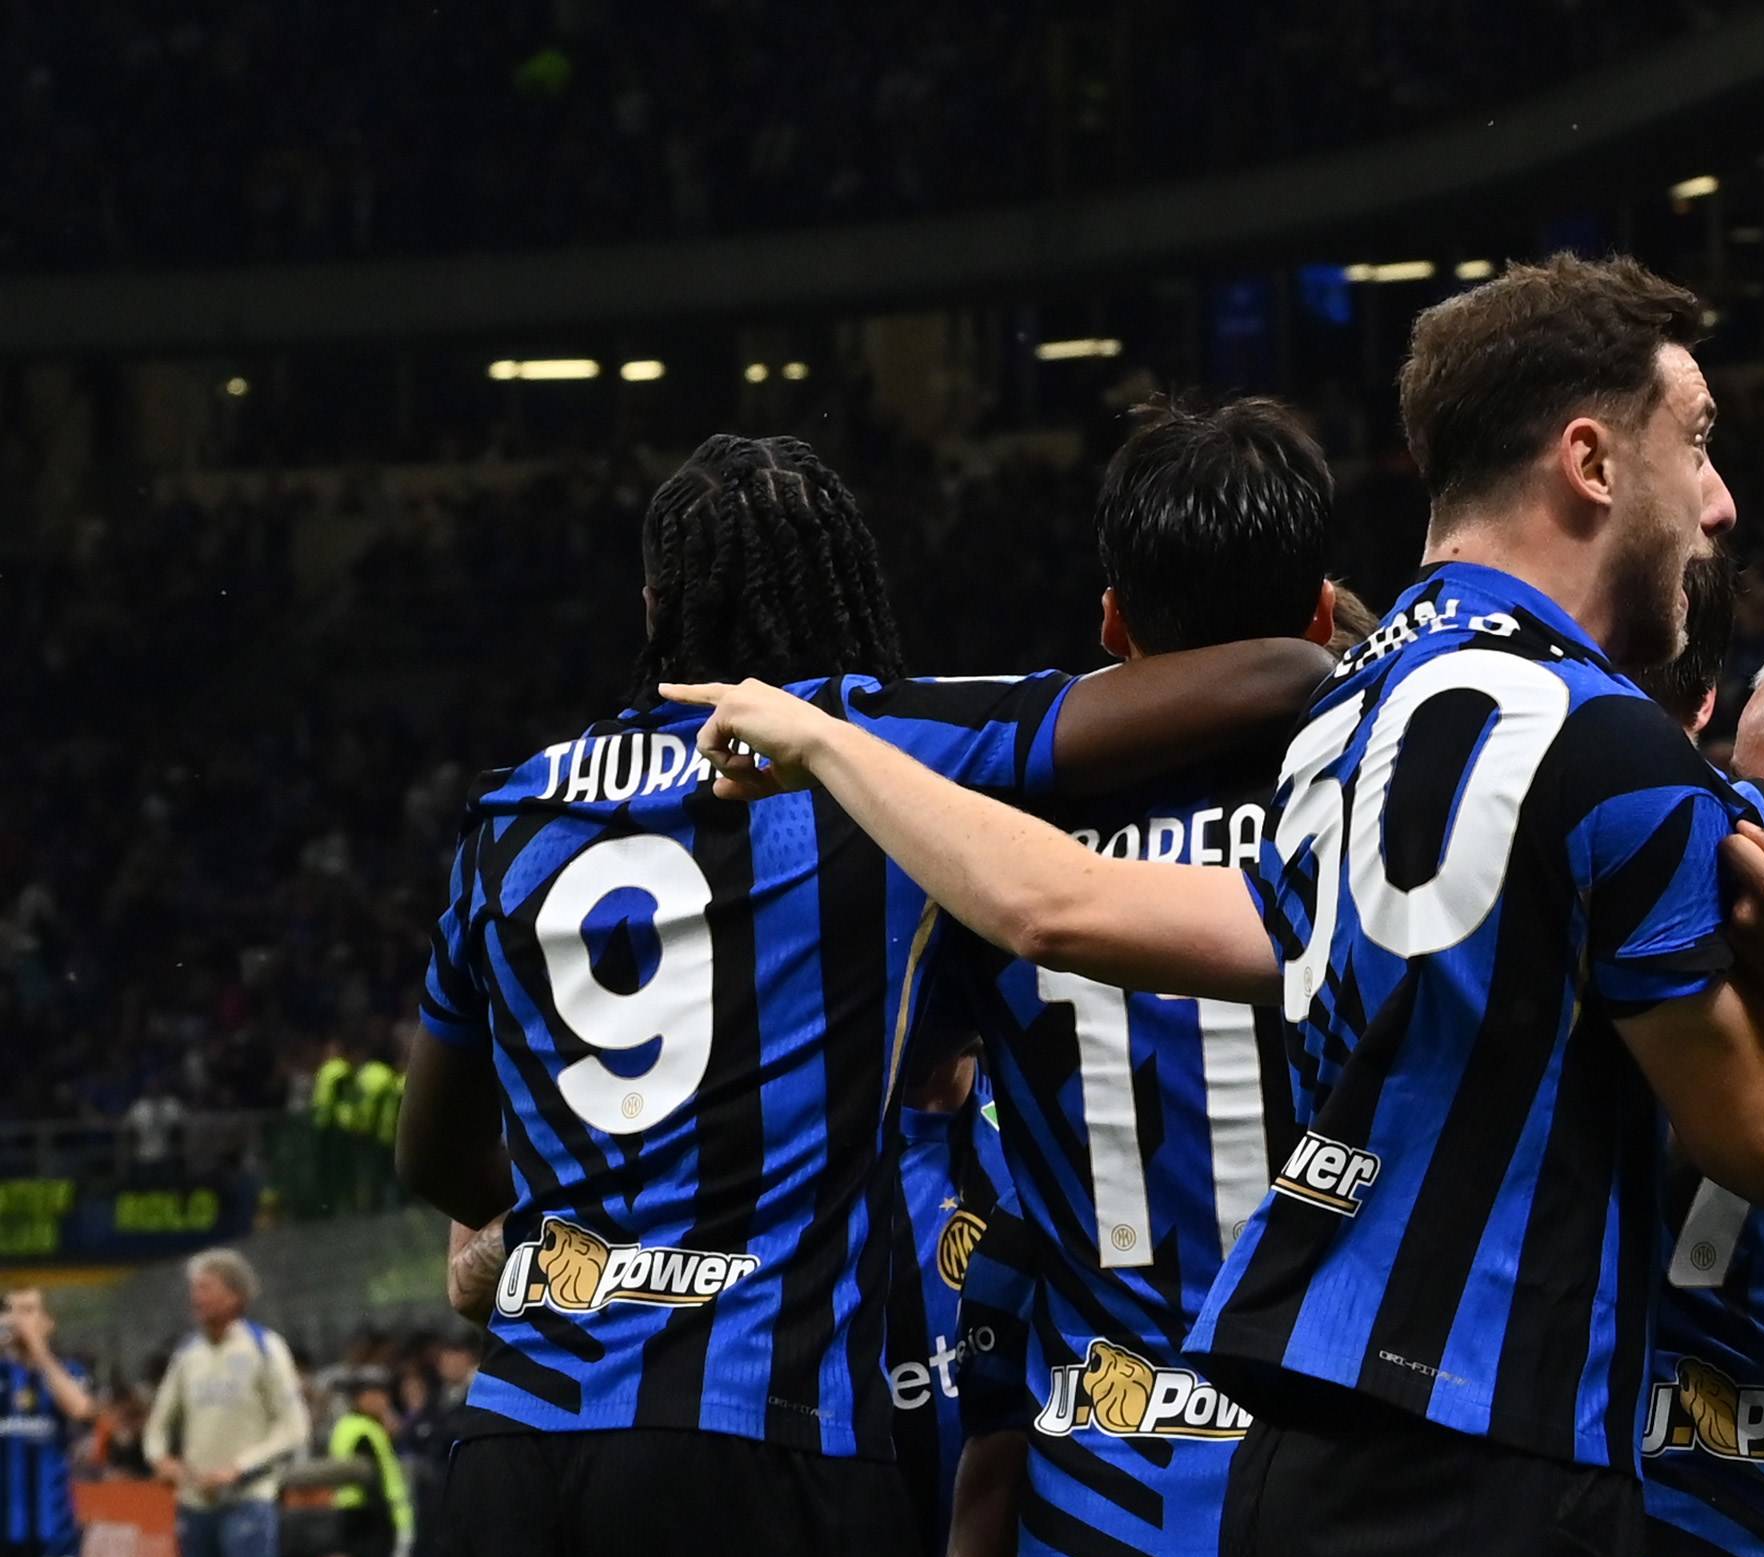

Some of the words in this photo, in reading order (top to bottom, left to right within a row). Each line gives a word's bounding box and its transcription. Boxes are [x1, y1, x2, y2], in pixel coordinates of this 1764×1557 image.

[535, 834, 713, 1135] 9
[1275, 648, 1570, 1023] 30
[1036, 966, 1270, 1270] 11
[1139, 1371, 1254, 1433] Pow
